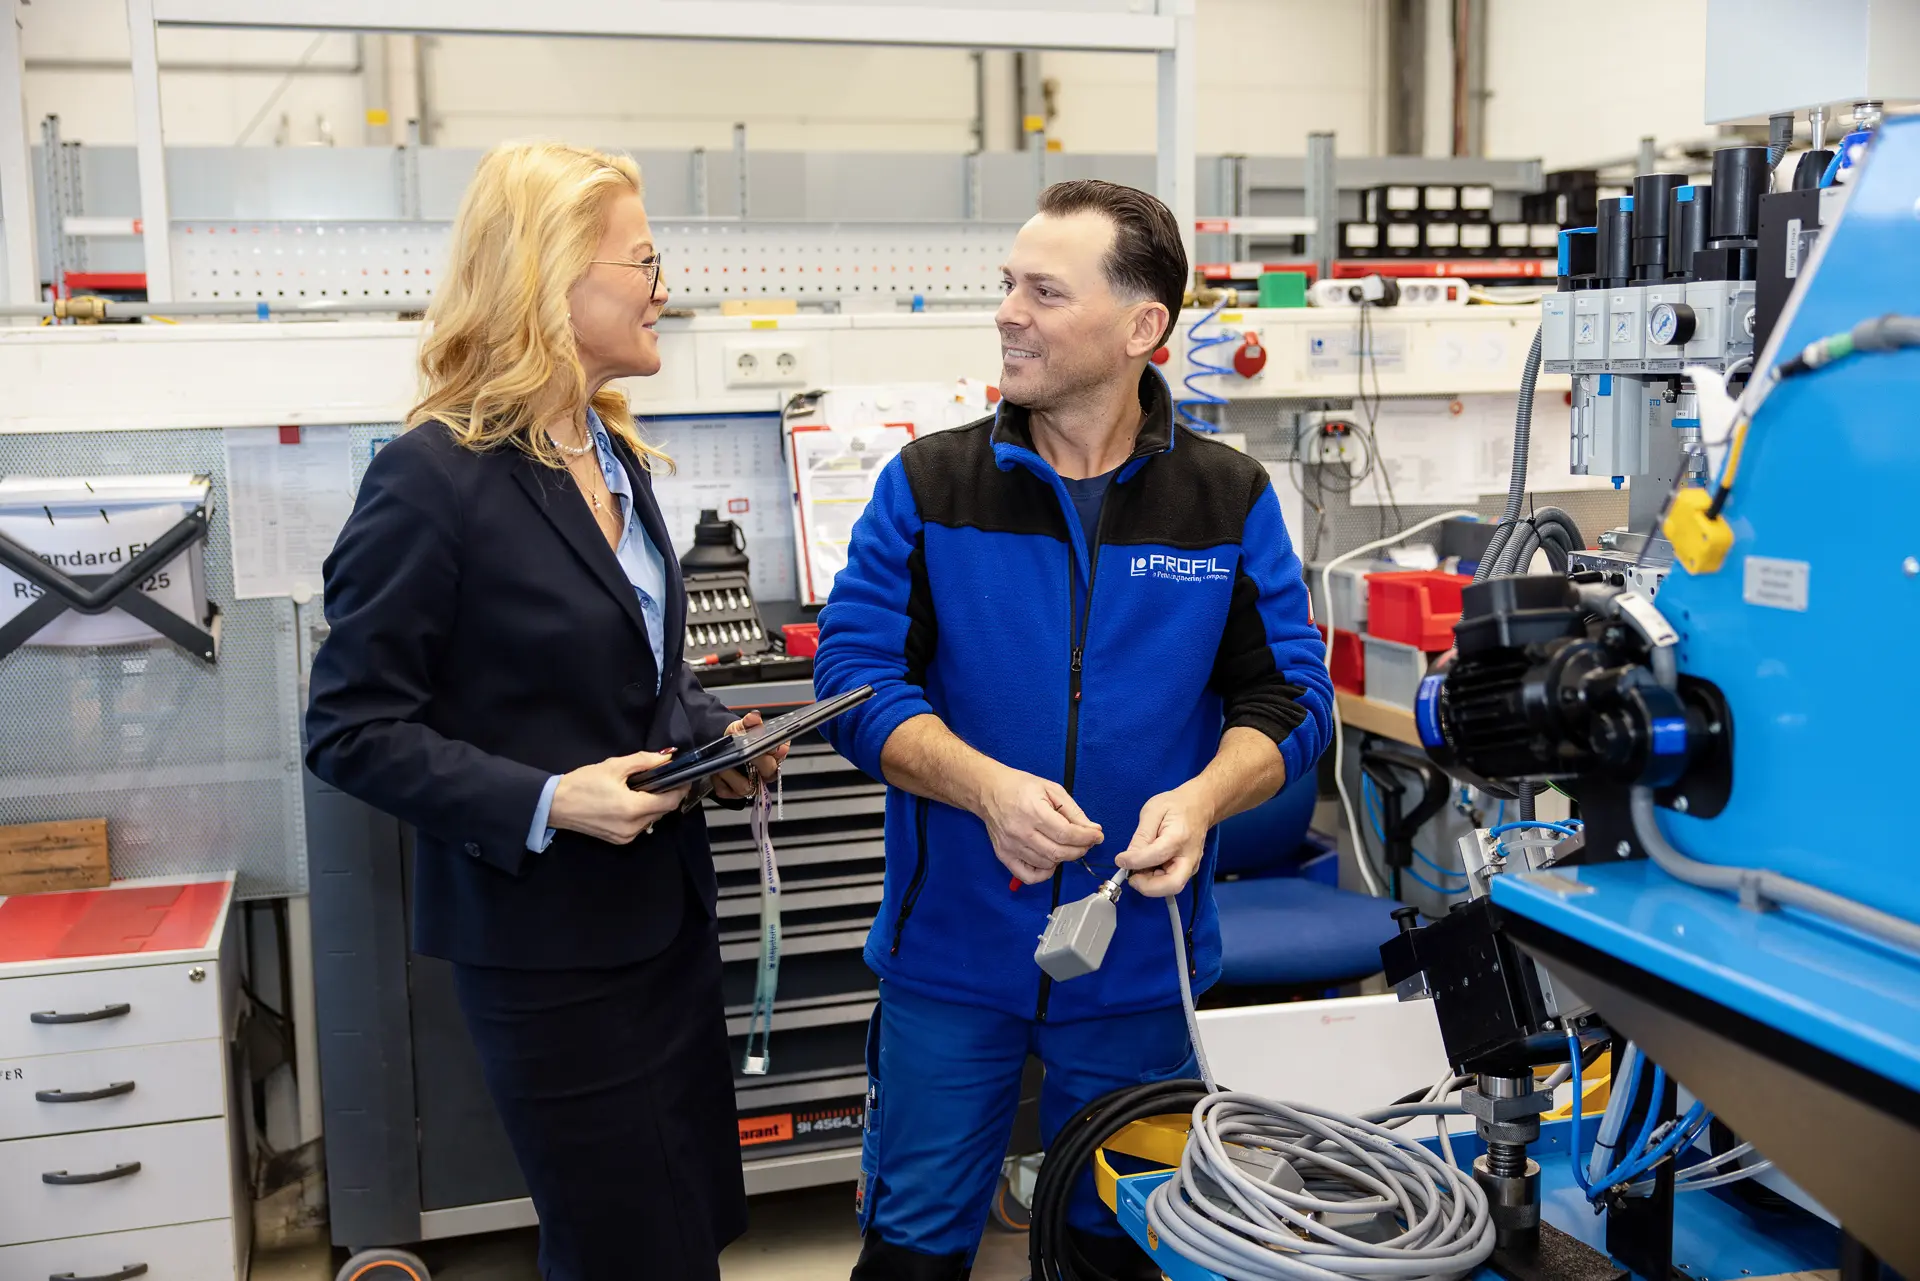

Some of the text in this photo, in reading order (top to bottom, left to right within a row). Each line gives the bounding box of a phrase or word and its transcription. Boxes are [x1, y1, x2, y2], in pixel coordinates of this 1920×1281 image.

[34, 547, 122, 566] andard
[1149, 554, 1230, 575] PROFIL
[139, 572, 171, 592] 25
